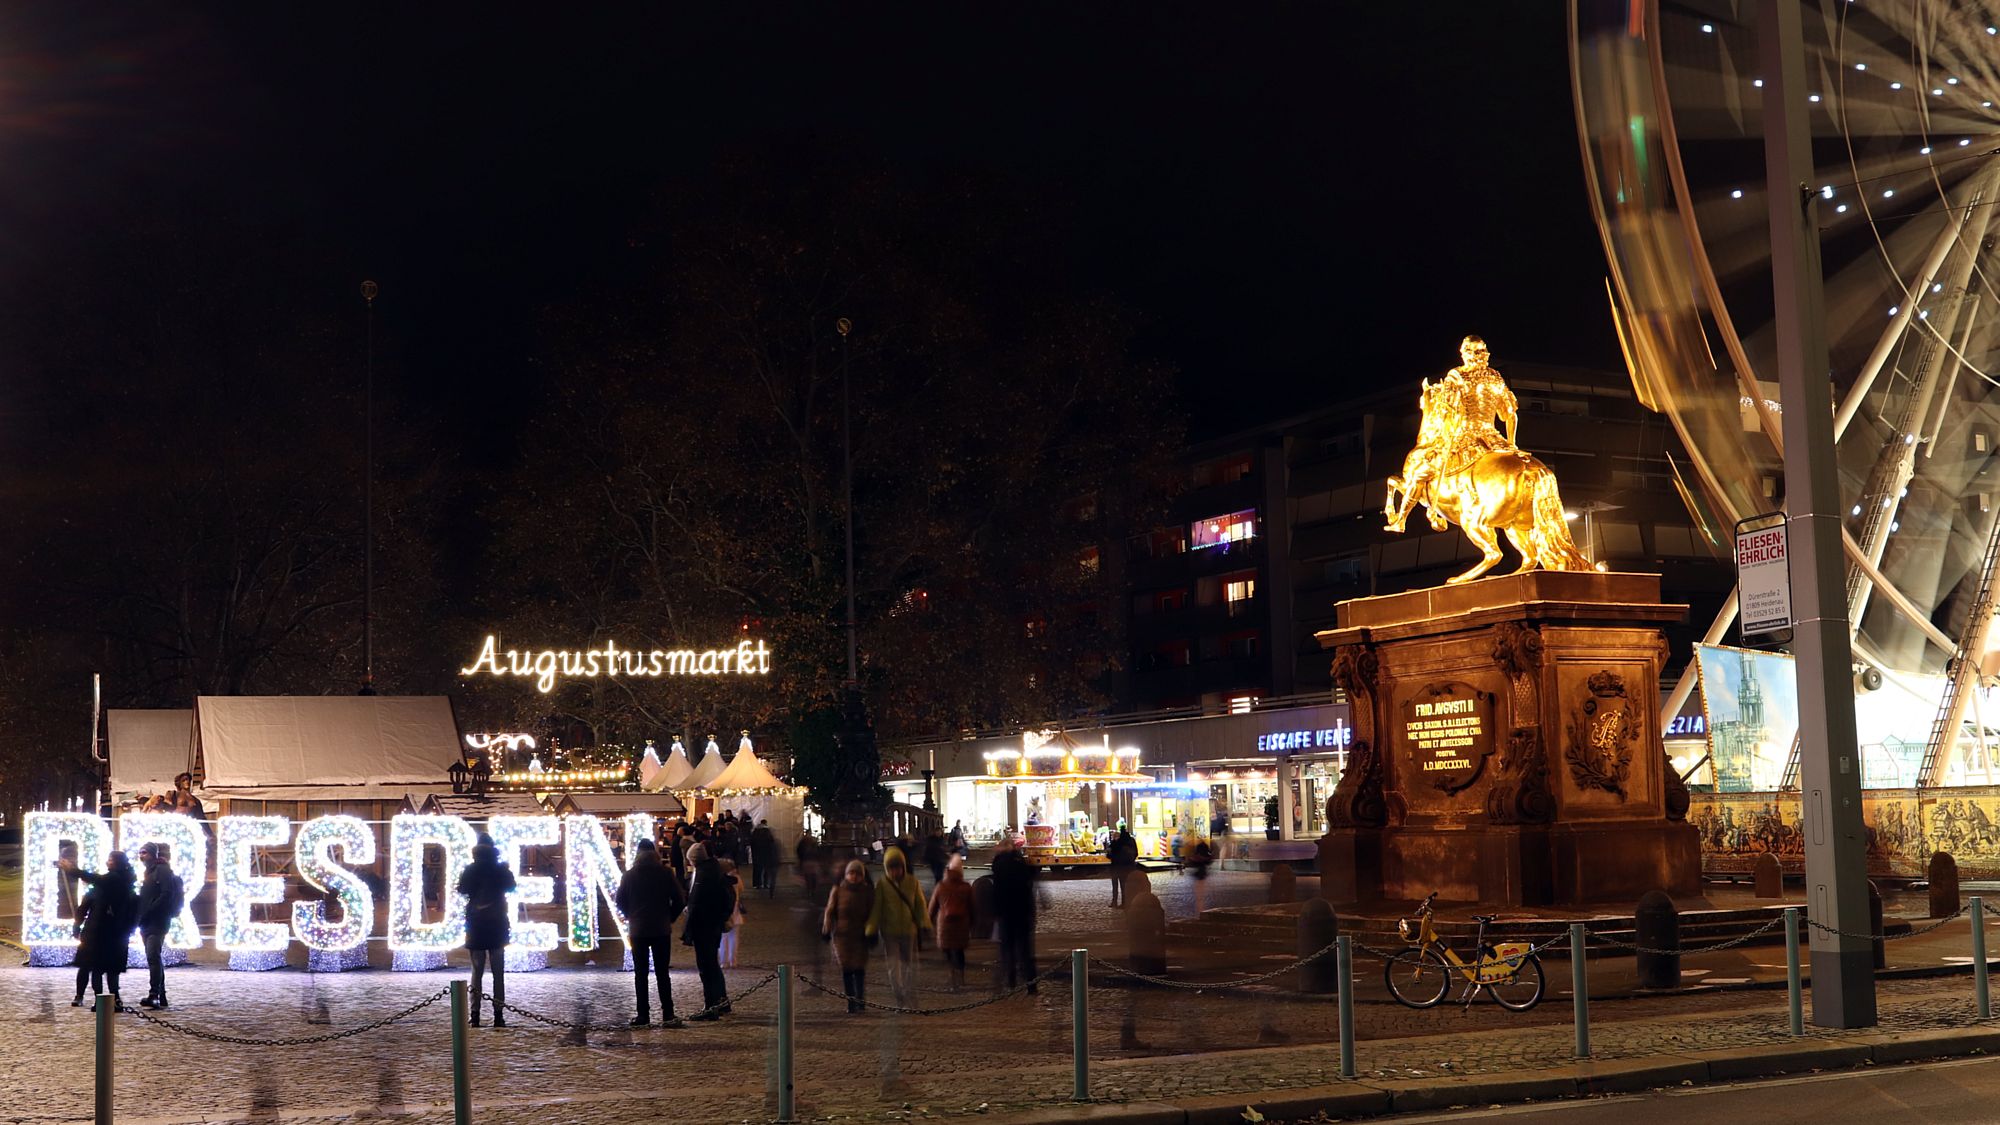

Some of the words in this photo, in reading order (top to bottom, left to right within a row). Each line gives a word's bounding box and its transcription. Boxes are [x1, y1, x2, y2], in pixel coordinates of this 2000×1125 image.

[1739, 531, 1783, 552] FLIESEN-
[1740, 545, 1784, 565] EHRLICH
[462, 635, 769, 693] Augustusmarkt
[1258, 731, 1312, 751] EISCAFE
[1432, 739, 1439, 748] ET
[22, 811, 655, 952] DRESDEN
